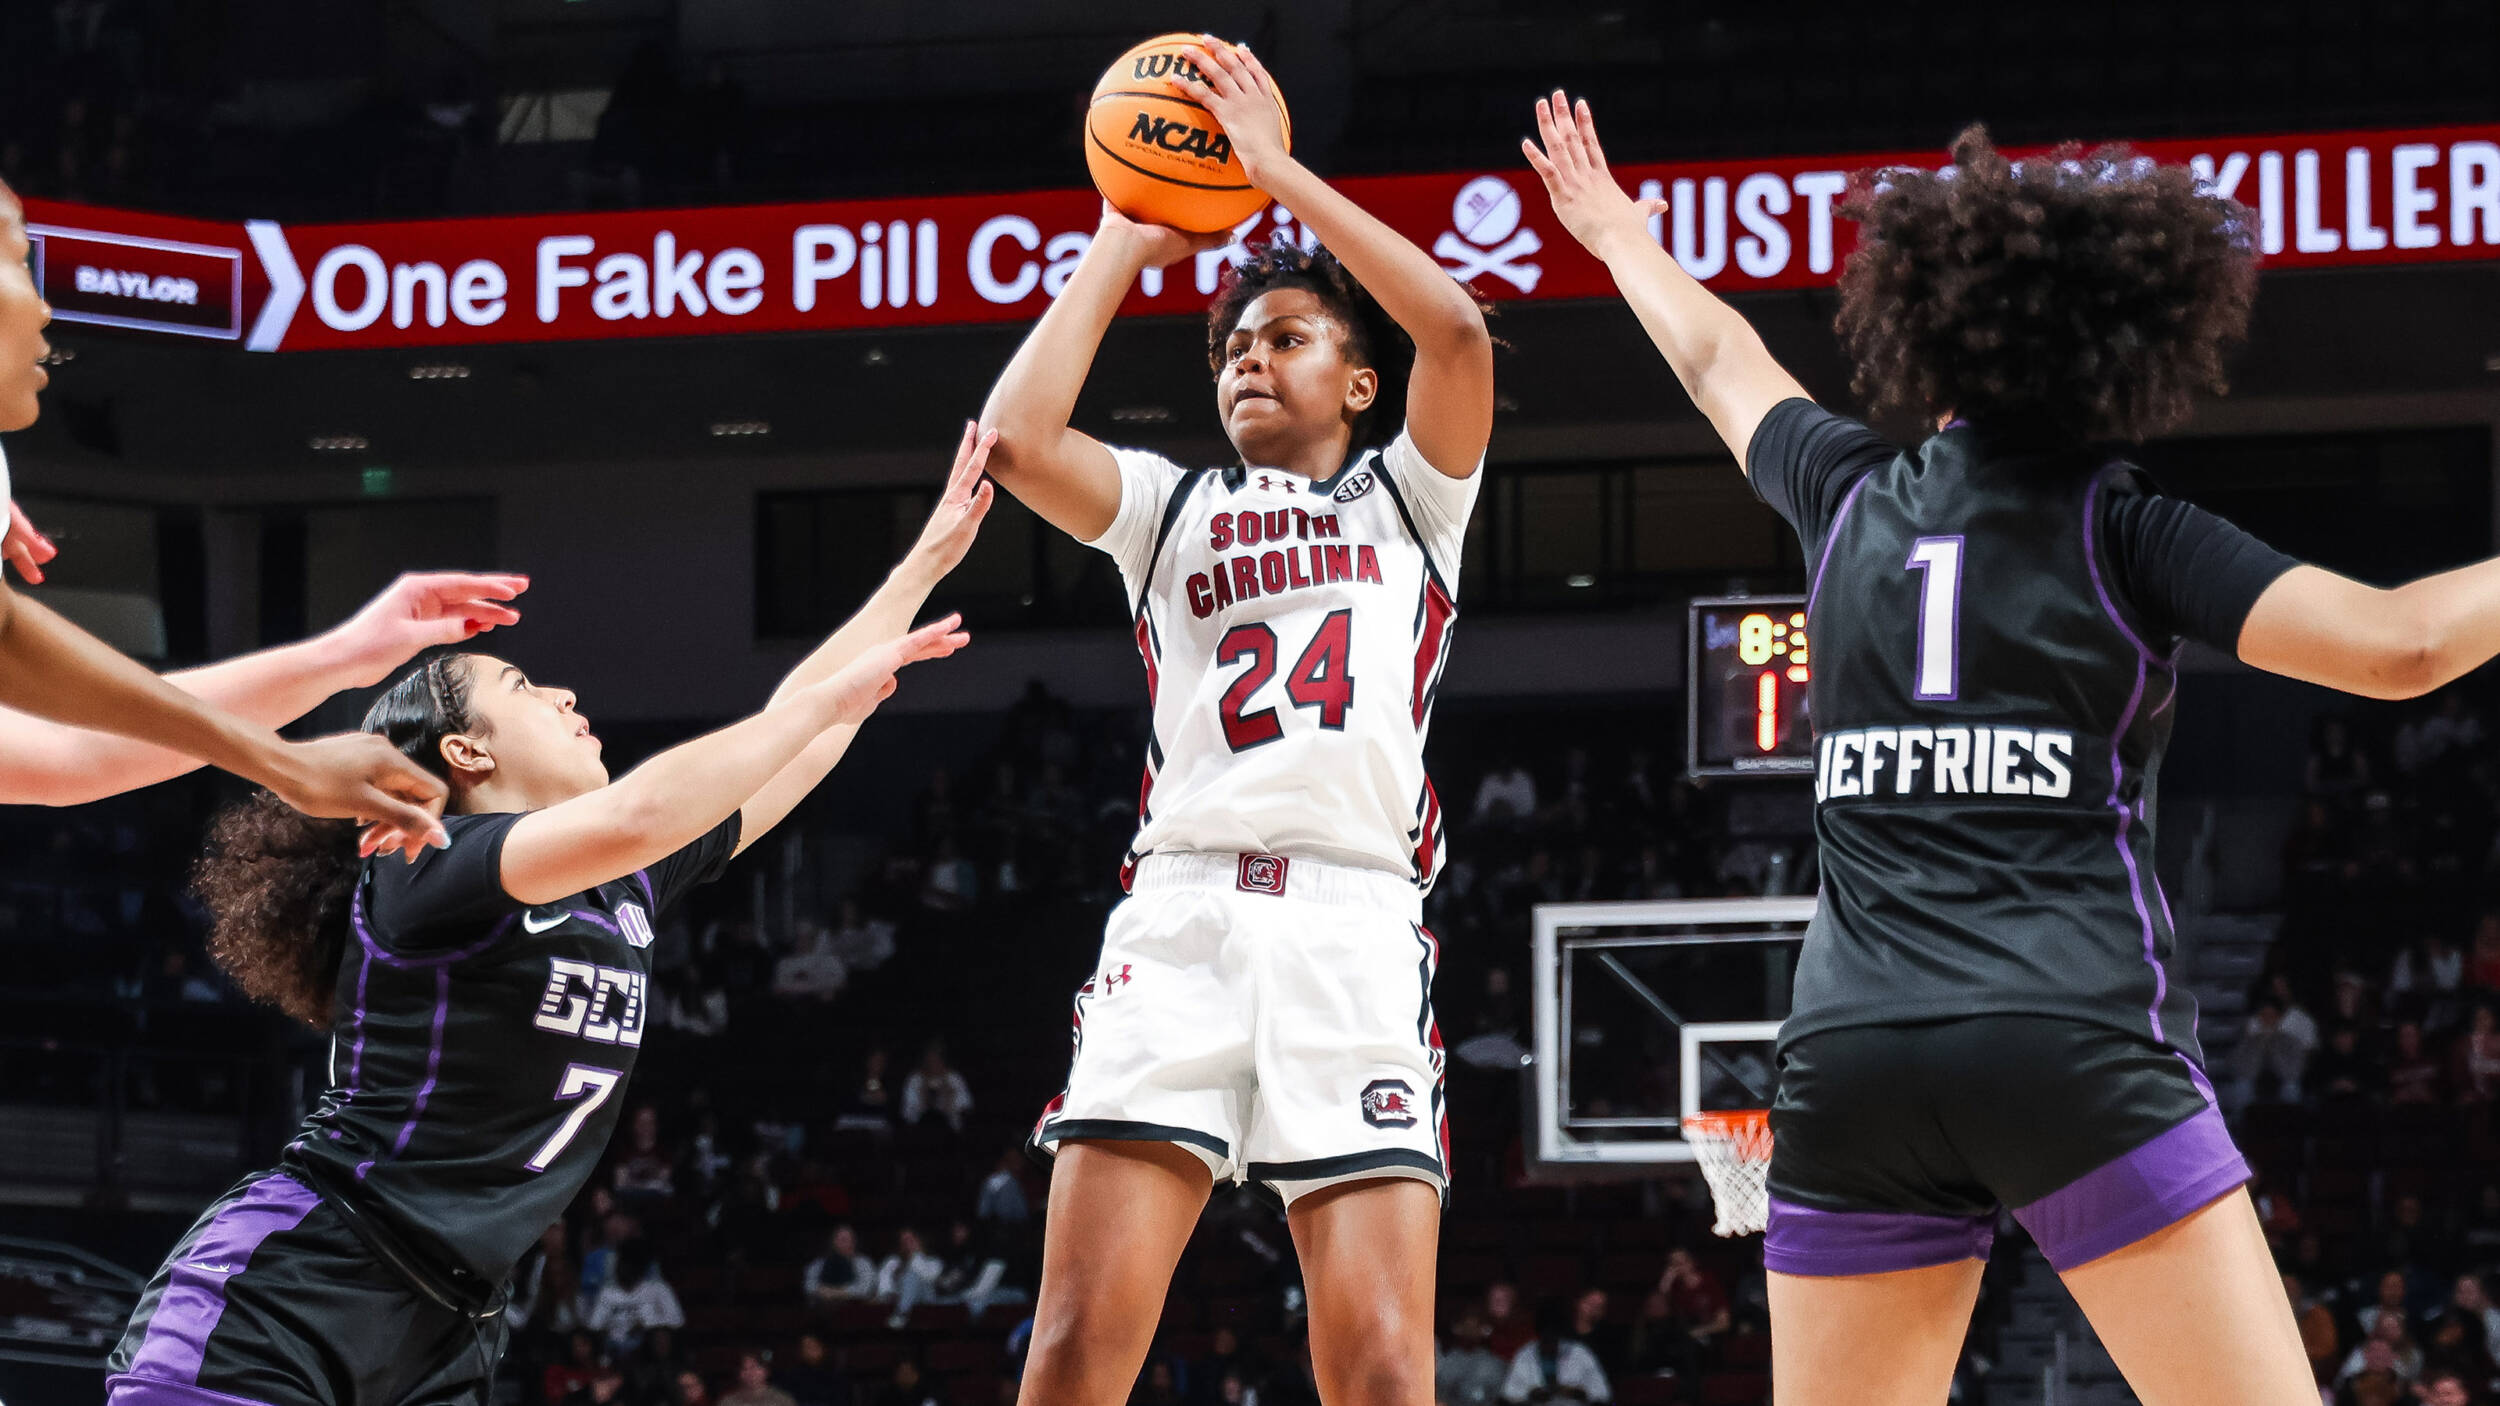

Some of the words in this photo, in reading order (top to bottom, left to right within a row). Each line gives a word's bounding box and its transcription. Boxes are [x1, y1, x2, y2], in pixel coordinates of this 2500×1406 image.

[1128, 112, 1231, 165] NCAA
[75, 264, 199, 305] BAYLOR
[313, 243, 507, 331] One
[536, 229, 765, 324] Fake
[792, 217, 938, 313] Pill
[966, 213, 1164, 304] Ca
[1336, 473, 1371, 501] SEC
[1210, 507, 1341, 552] SOUTH
[1185, 544, 1384, 620] CAROLINA
[1905, 535, 1964, 701] 1
[1216, 607, 1355, 754] 24
[1815, 727, 2073, 804] JEFFRIES
[524, 1062, 624, 1173] 7
